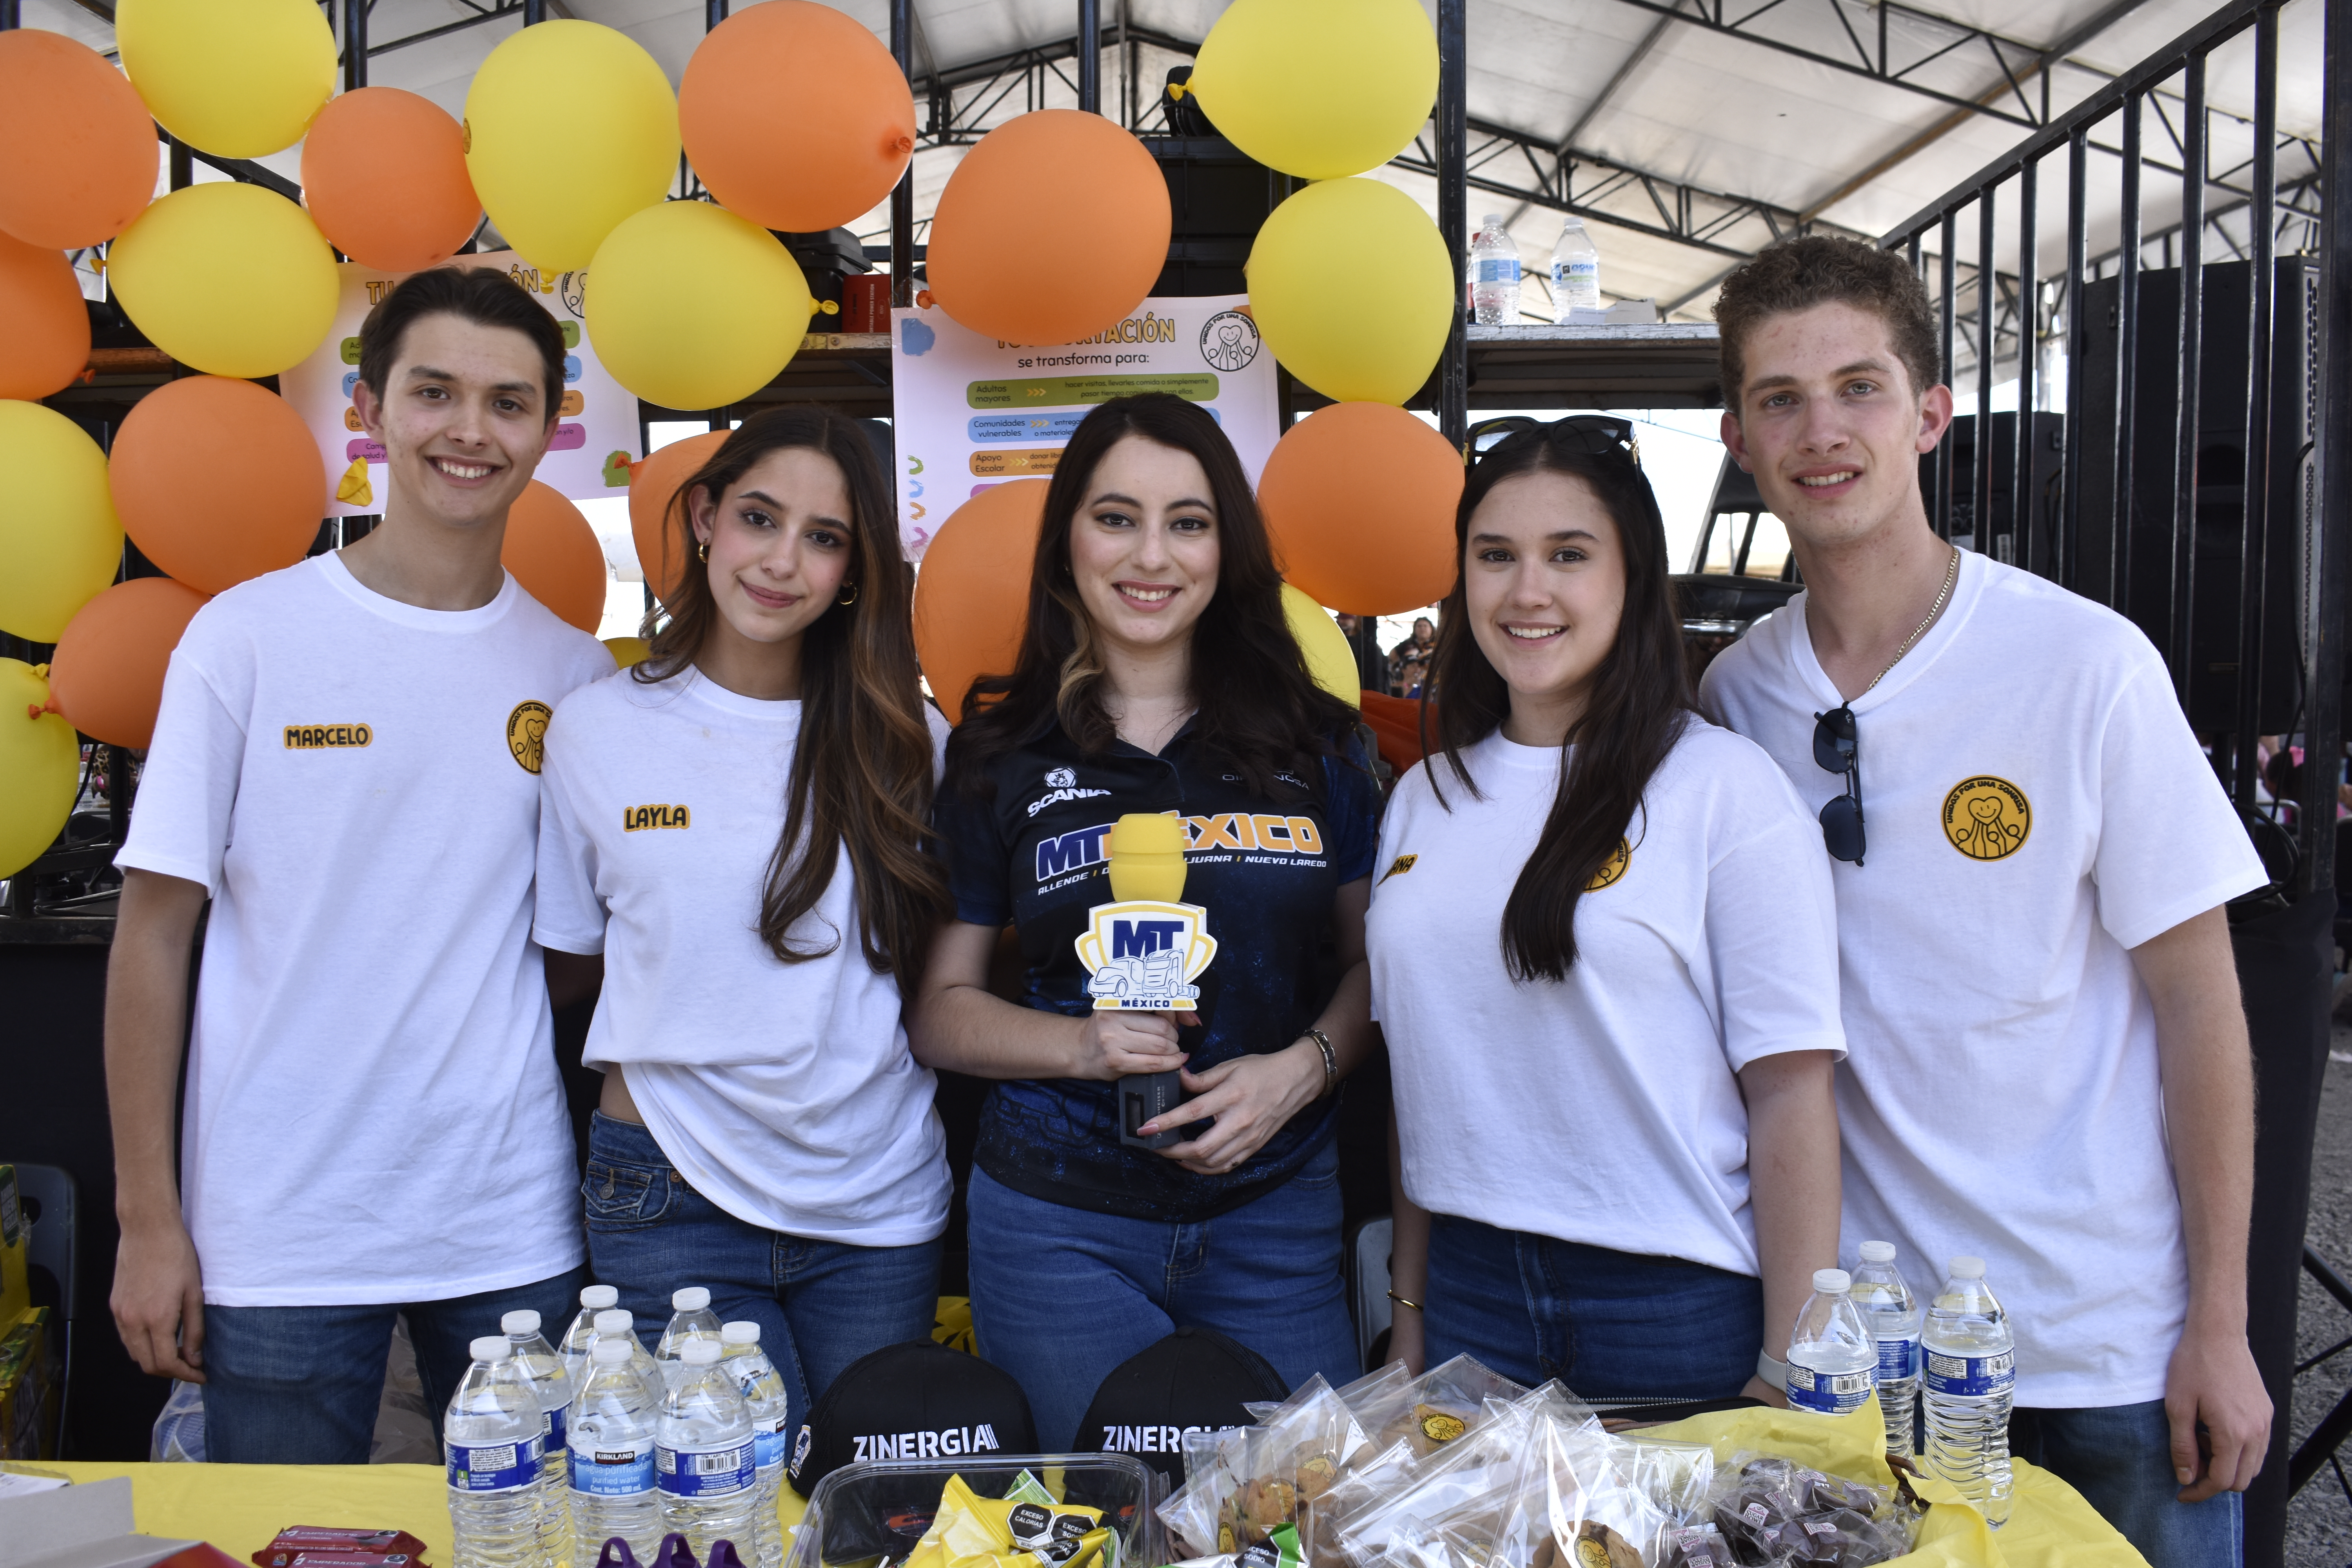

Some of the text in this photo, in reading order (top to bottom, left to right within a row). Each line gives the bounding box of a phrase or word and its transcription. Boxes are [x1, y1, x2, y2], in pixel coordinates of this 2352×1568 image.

[1213, 315, 1225, 324] POR
[1018, 352, 1149, 368] se transforma para:
[1167, 377, 1209, 386] simplemente
[976, 385, 1007, 394] Adultos
[975, 395, 1011, 403] mayores
[974, 419, 1025, 428] Comunidades
[978, 429, 1022, 437] vulnerables
[976, 454, 1002, 464] Apoyo
[975, 464, 1005, 472] Escolar
[521, 706, 532, 714] POR
[287, 727, 368, 746] MARCELO
[1027, 789, 1112, 817] SCANIA
[1947, 793, 1960, 824] UNIDOS
[1958, 782, 1976, 795] POR
[1997, 784, 2025, 815] SONRISA
[626, 807, 686, 829] LAYLA
[1245, 856, 1327, 867] NUEVO LAREDO
[1038, 871, 1089, 895] ALLENDE
[1112, 920, 1184, 959] MT
[1121, 998, 1170, 1007] MÉXICO
[853, 1424, 1000, 1462] ZINERGIA
[585, 1462, 648, 1475] agua purificada
[592, 1475, 640, 1485] purified water
[590, 1485, 603, 1493] Cont.
[1021, 1509, 1044, 1520] EXCESO
[1746, 1510, 1763, 1521] SUGAR
[1014, 1515, 1044, 1528] CALORÍAS
[1063, 1522, 1087, 1534] EXCESO
